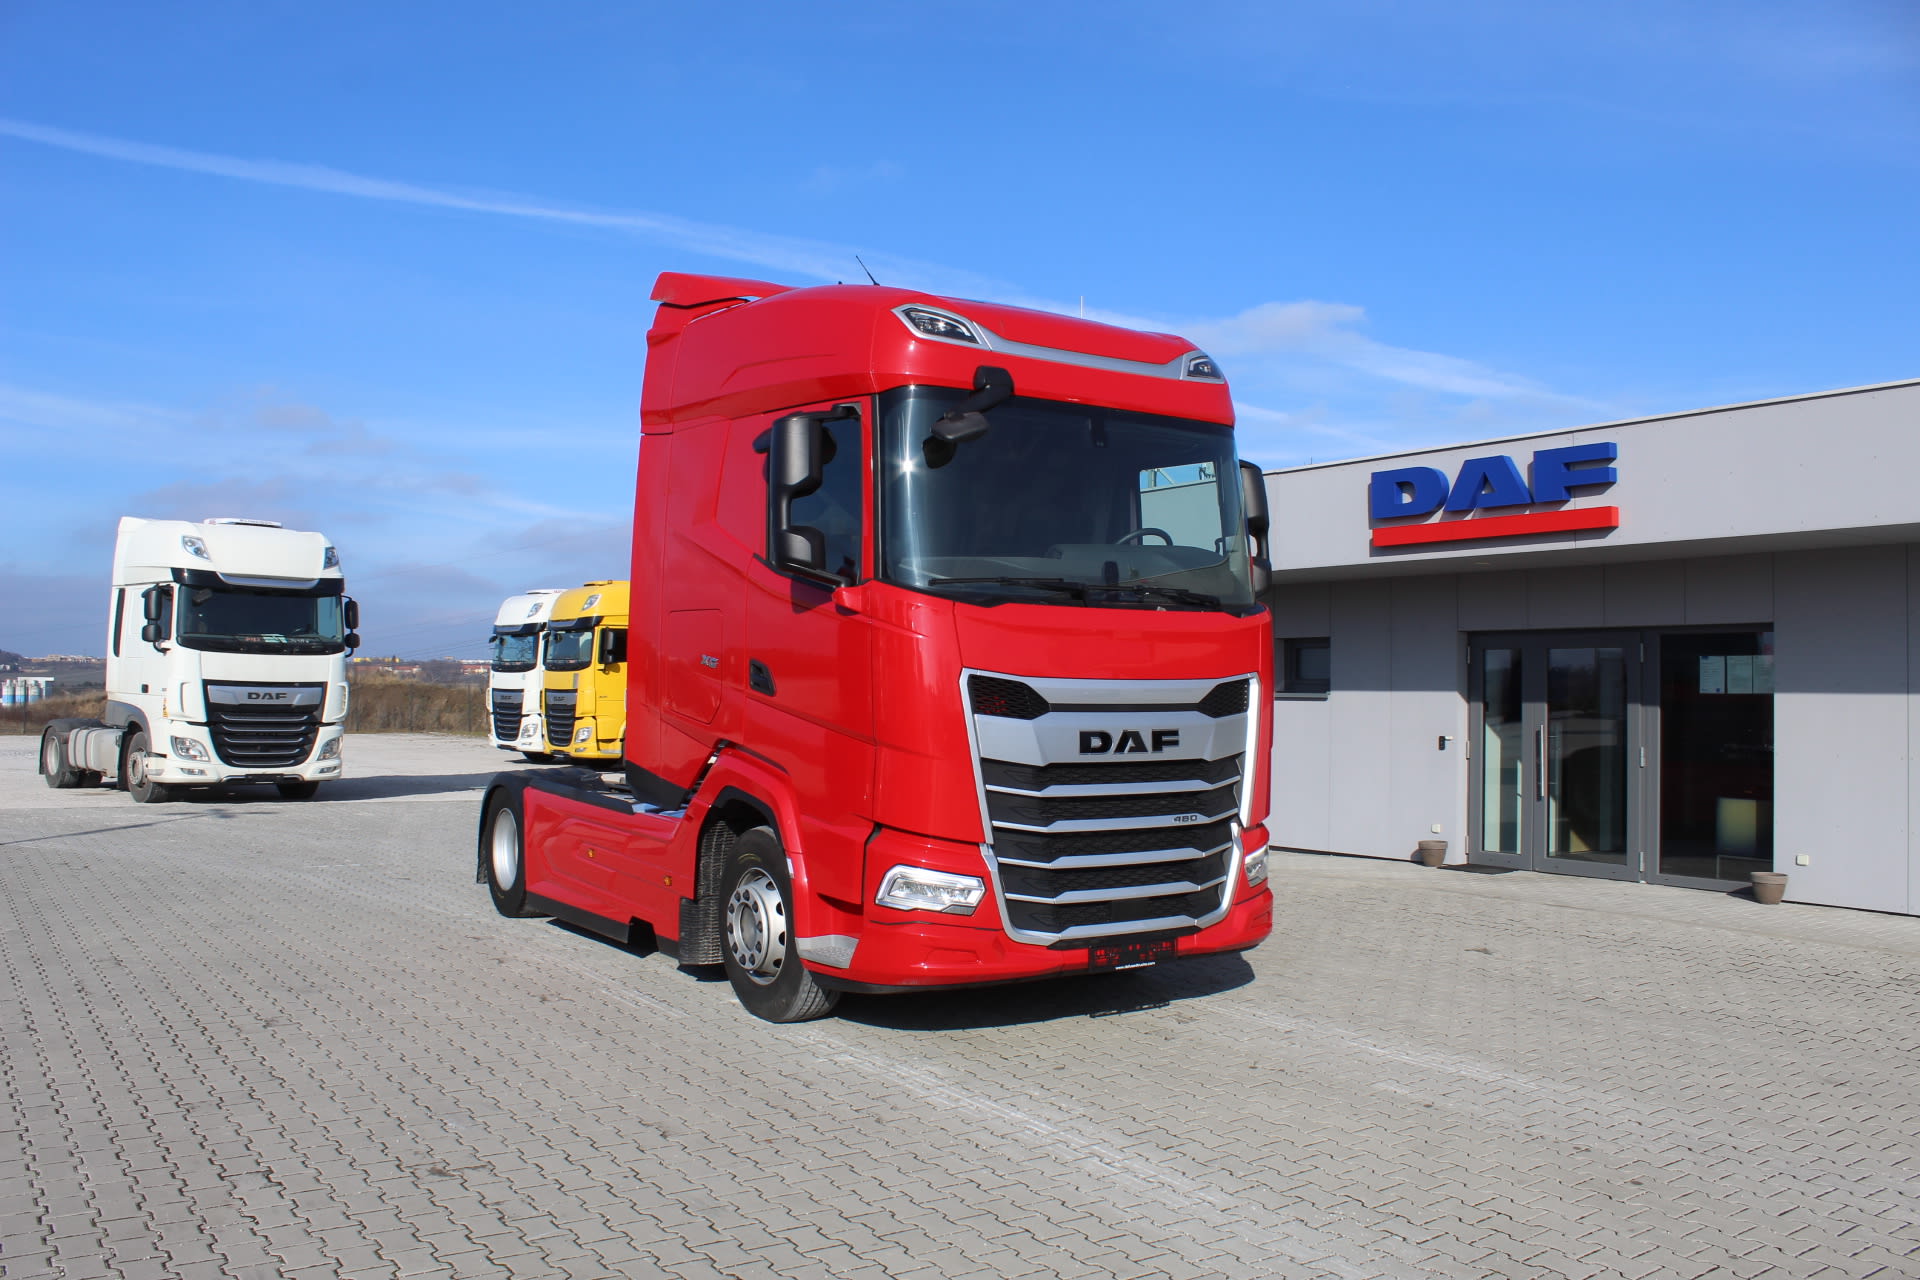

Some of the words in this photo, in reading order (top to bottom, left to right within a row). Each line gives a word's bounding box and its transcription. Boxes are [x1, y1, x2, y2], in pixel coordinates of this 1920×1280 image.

[1371, 441, 1617, 519] DAF
[247, 692, 288, 700] DAF
[1079, 728, 1180, 754] DAF
[1173, 814, 1198, 823] 480
